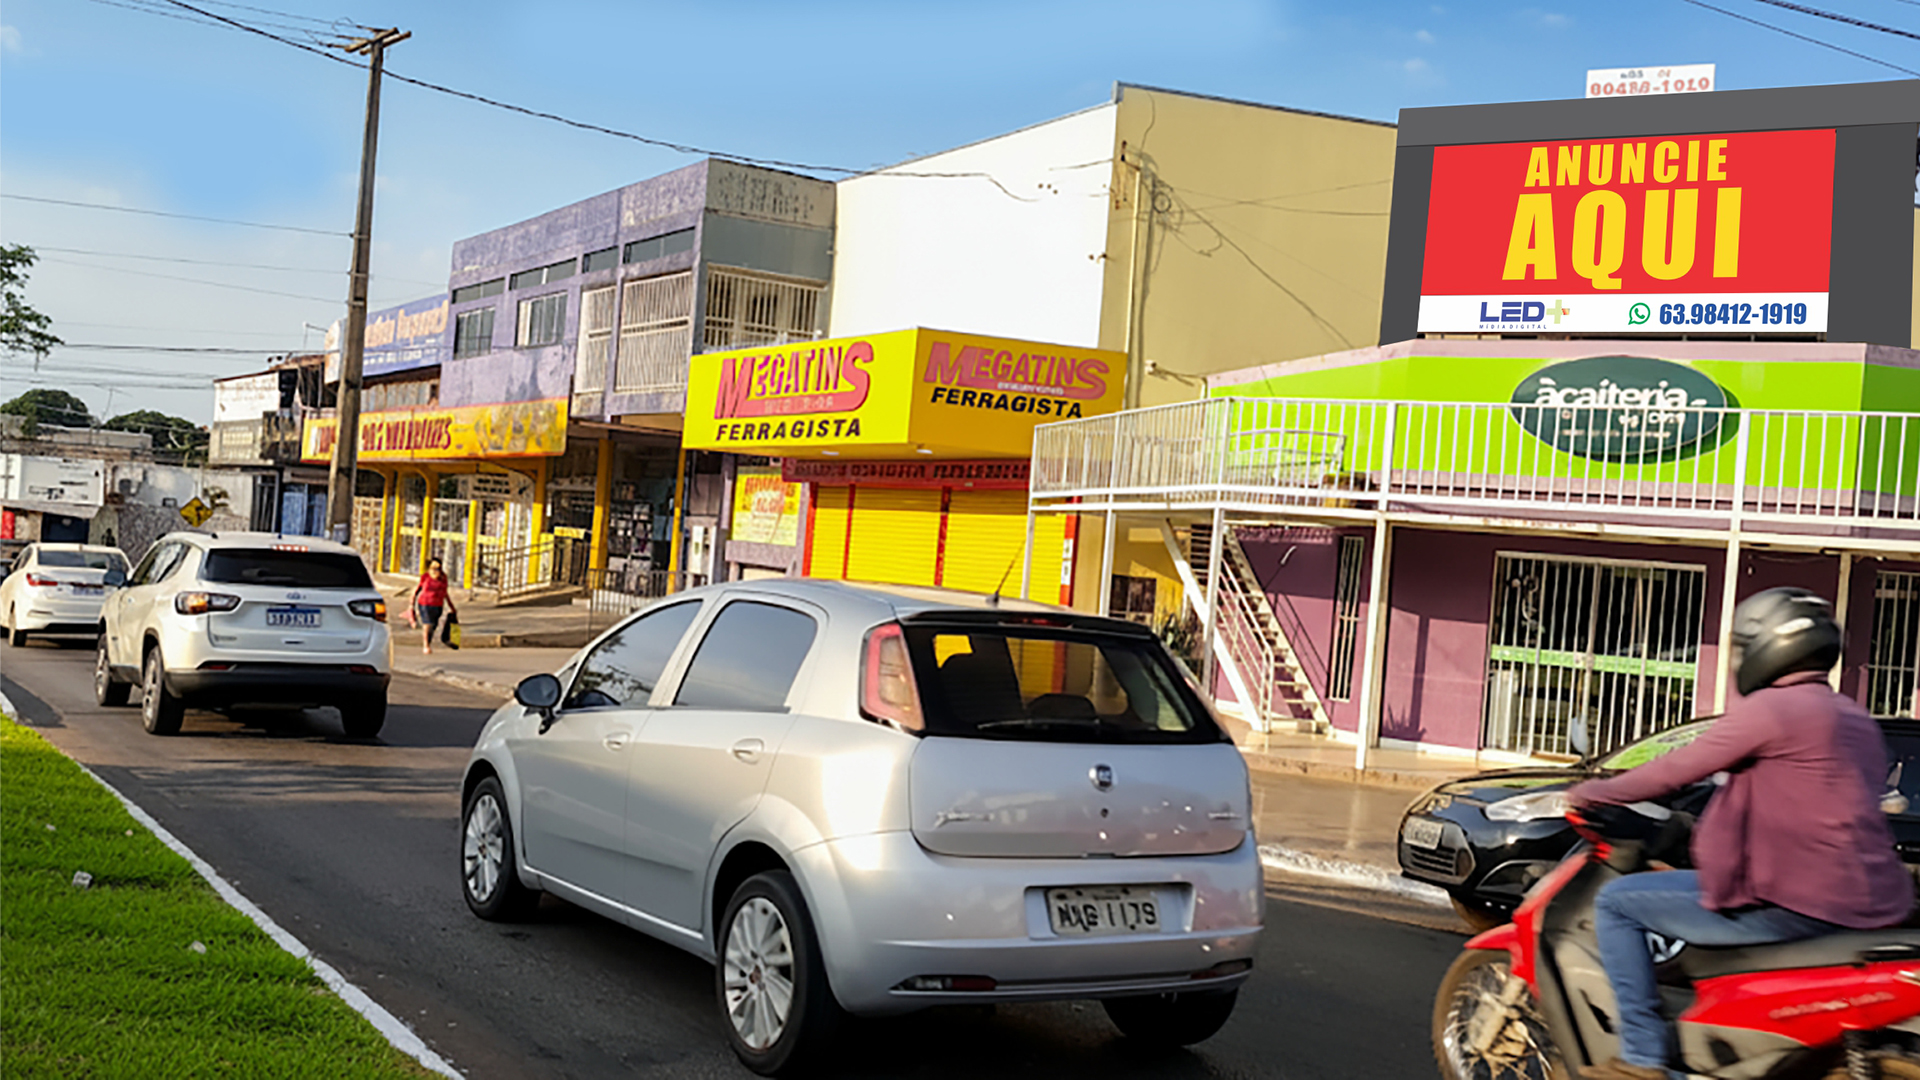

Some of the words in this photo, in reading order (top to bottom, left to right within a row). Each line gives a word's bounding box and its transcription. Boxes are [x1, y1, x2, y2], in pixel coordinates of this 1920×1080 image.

[1524, 139, 1728, 187] ANUNCIE
[1502, 187, 1742, 289] AQUI
[1659, 302, 1807, 325] 63.98412-1919
[714, 341, 874, 419] MEGATINS
[924, 341, 1110, 400] MEGATINS
[931, 386, 1083, 419] FERRAGISTA
[716, 418, 861, 441] FERRAGISTA
